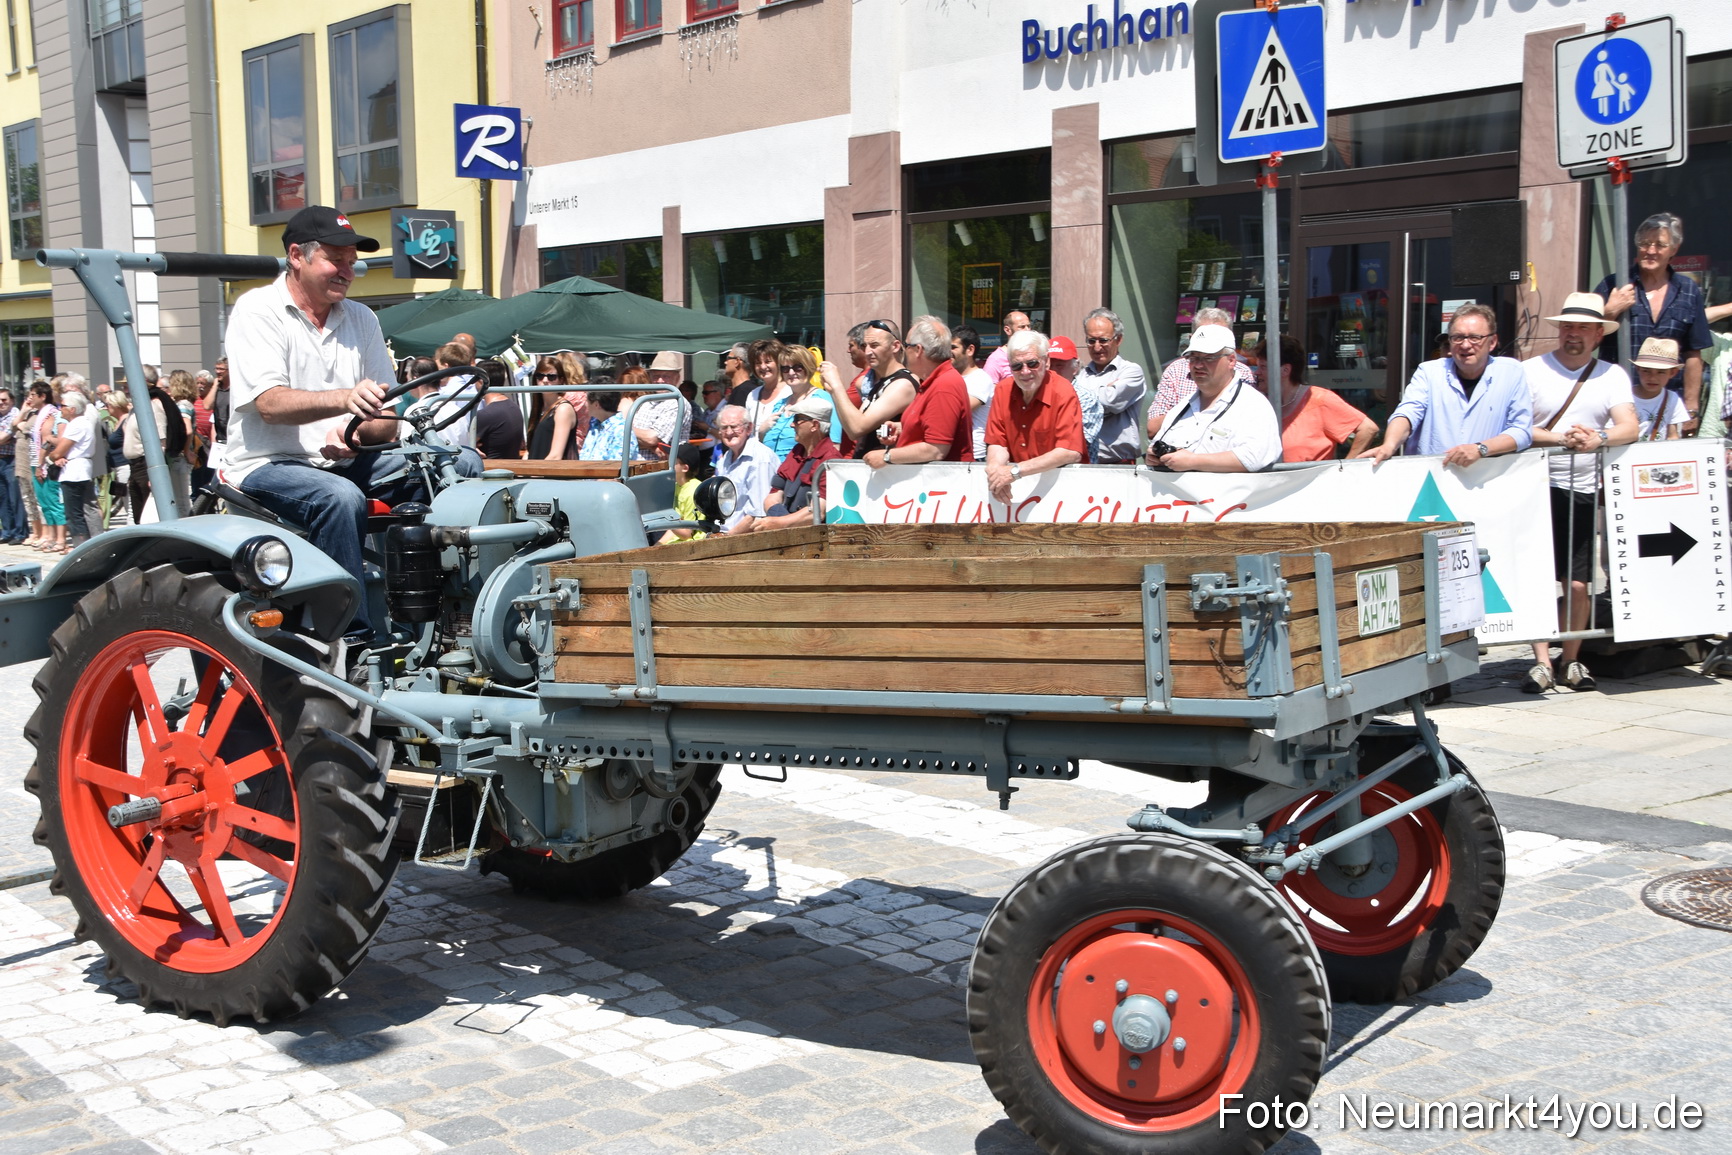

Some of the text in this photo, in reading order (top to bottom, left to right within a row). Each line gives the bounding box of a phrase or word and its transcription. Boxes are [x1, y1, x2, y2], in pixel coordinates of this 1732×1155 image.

[1022, 0, 1189, 64] Buchhan
[1586, 125, 1643, 154] ZONE
[529, 195, 578, 214] Unterer Markt 15
[419, 228, 441, 256] G2
[1611, 464, 1632, 620] RESIDENZPLATZ
[1706, 456, 1726, 612] RESIDENZPLATZ
[1451, 549, 1470, 572] 235
[1371, 572, 1387, 602] NM
[1363, 599, 1399, 632] AH 742
[1480, 619, 1514, 634] GmbH
